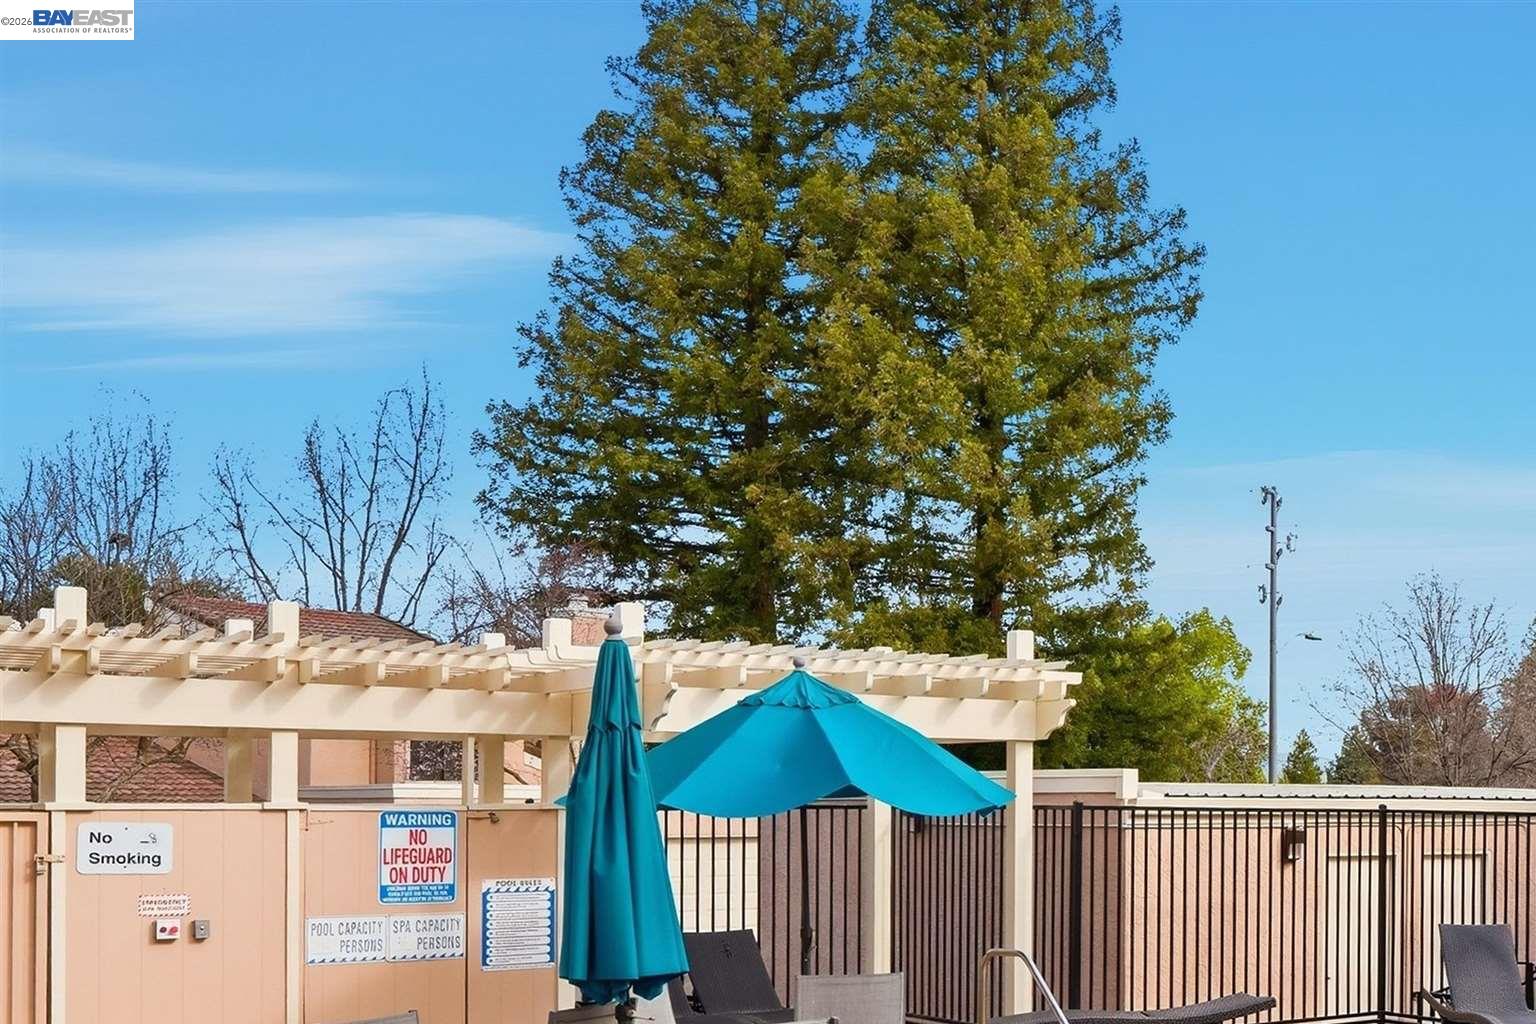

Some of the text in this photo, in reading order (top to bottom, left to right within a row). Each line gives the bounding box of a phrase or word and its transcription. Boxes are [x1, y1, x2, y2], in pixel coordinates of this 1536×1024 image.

[385, 814, 452, 825] WARNING
[89, 832, 112, 843] No
[409, 829, 427, 845] NO
[88, 852, 161, 867] Smoking
[383, 848, 452, 864] LIFEGUARD
[389, 866, 446, 883] ON DUTY
[311, 921, 384, 936] POOL CAPACITY
[392, 919, 461, 933] SPA CAPACITY
[340, 938, 383, 953] PERSONS
[417, 936, 461, 950] PERSONS
